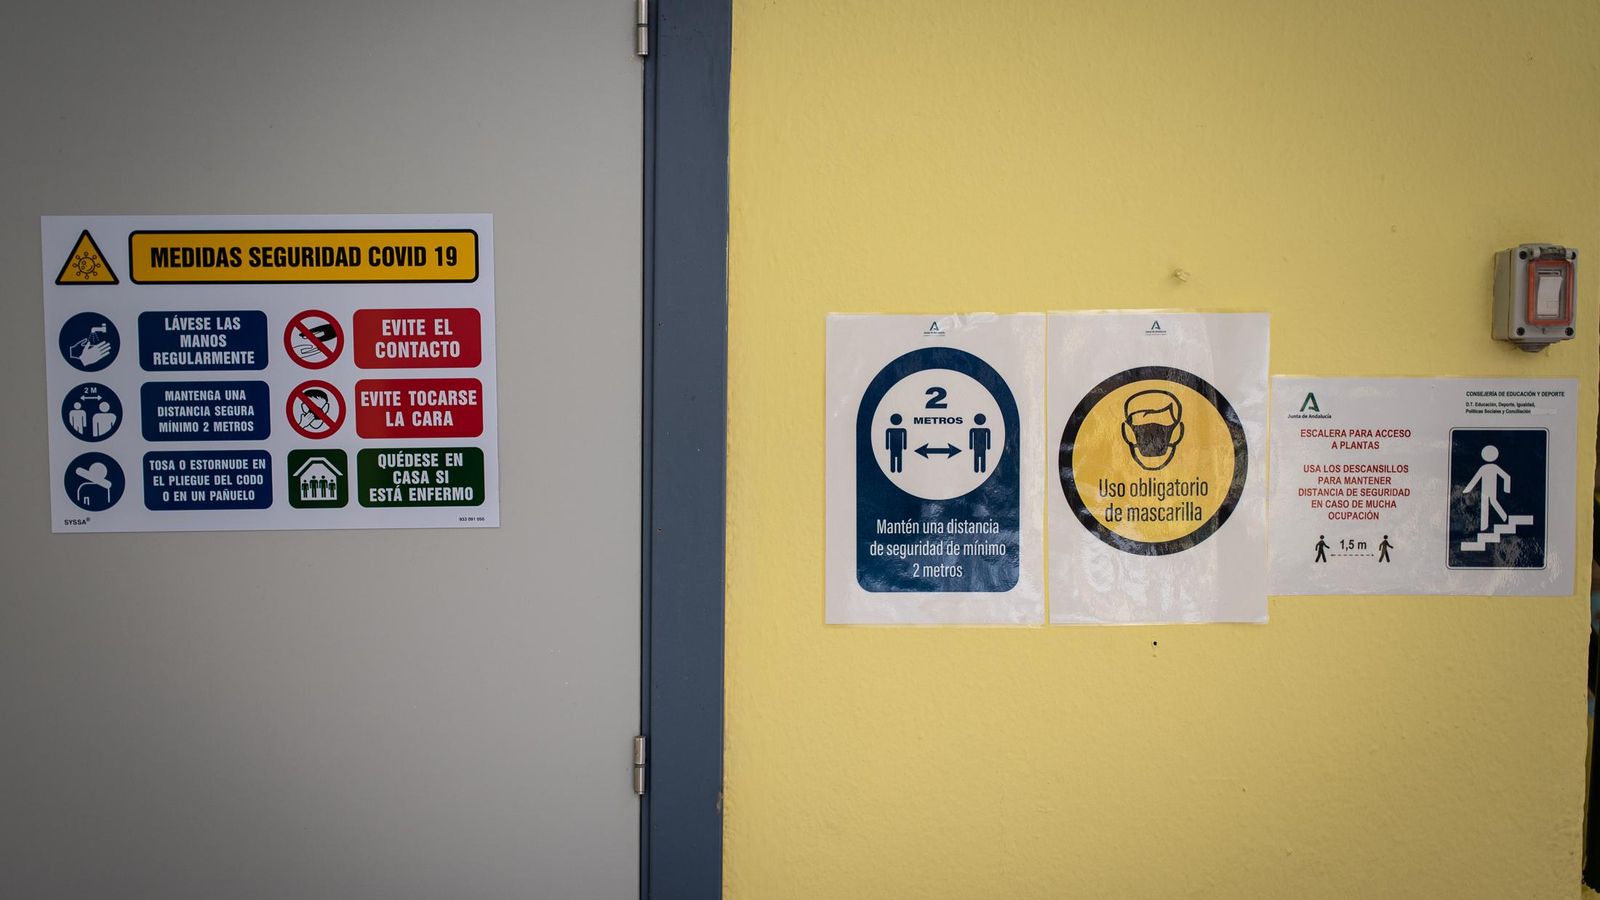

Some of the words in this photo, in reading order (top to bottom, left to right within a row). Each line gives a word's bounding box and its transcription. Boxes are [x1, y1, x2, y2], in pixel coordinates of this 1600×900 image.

[151, 247, 242, 268] MEDIDAS
[249, 246, 362, 268] SEGURIDAD
[368, 246, 427, 266] COVID
[434, 246, 458, 266] 19
[165, 315, 211, 331] LÁVESE
[216, 316, 240, 330] LAS
[382, 319, 426, 336] EVITE
[434, 318, 452, 336] EL
[180, 334, 226, 348] MANOS
[375, 341, 460, 358] CONTACTO
[153, 351, 254, 366] REGULARMENTE
[165, 390, 220, 401] MANTENGA
[225, 390, 246, 400] UNA
[360, 390, 401, 407] EVITE
[408, 390, 477, 406] TOCARSE
[925, 386, 948, 409] 2
[157, 406, 210, 417] DISTANCIA
[214, 405, 254, 416] SEGURA
[386, 411, 404, 427] LA
[412, 410, 454, 427] CARA
[914, 416, 964, 425] METROS
[159, 420, 199, 432] MÍNIMO
[203, 422, 209, 432] 2
[214, 421, 254, 432] METROS
[1300, 429, 1347, 438] ESCALERA
[1349, 429, 1373, 438] PARA
[1374, 429, 1412, 438] ACCESO
[1331, 441, 1338, 450] A
[1340, 441, 1380, 450] PLANTAS
[149, 460, 175, 470] TOSA
[180, 460, 186, 470] O
[190, 459, 248, 470] ESTORNUDE
[252, 458, 266, 470] EN
[378, 450, 438, 468] QUÉDESE
[446, 452, 463, 467] EN
[1304, 464, 1322, 473] USA
[1323, 464, 1341, 473] LOS
[1343, 464, 1409, 473] DESCANSILLOS
[153, 476, 165, 486] EL
[168, 475, 210, 486] PLIEGUE
[214, 474, 232, 486] DEL
[236, 474, 264, 485] CODO
[392, 470, 430, 485] CASA
[436, 470, 449, 484] SI
[1318, 476, 1342, 485] PARA
[1344, 476, 1392, 485] MANTENER
[162, 491, 169, 502] O
[174, 491, 187, 502] EN
[192, 490, 206, 501] UN
[210, 488, 255, 501] PAÑUELO
[370, 484, 402, 502] ESTÁ
[408, 486, 474, 501] ENFERMO
[1099, 479, 1126, 498] Uso
[1130, 477, 1208, 501] obligatorio
[1298, 488, 1344, 497] DISTANCIA
[1346, 488, 1358, 497] DE
[1359, 488, 1410, 497] SEGURIDAD
[1312, 500, 1323, 509] EN
[1325, 500, 1350, 509] CASO
[1352, 500, 1363, 509] DE
[1365, 500, 1397, 509] MUCHA
[1105, 502, 1122, 522] de
[1127, 502, 1202, 522] mascarilla
[1328, 510, 1380, 520] OCUPACIÓN
[876, 518, 920, 534] Mantén
[922, 522, 944, 534] una
[947, 518, 999, 534] distancia
[870, 540, 884, 556] de
[886, 540, 944, 559] seguridad
[946, 540, 960, 556] de
[963, 540, 1006, 556] mínimo
[1340, 540, 1354, 551] 1,5
[1358, 542, 1367, 550] m
[912, 563, 920, 578] 2
[923, 564, 962, 578] metros
